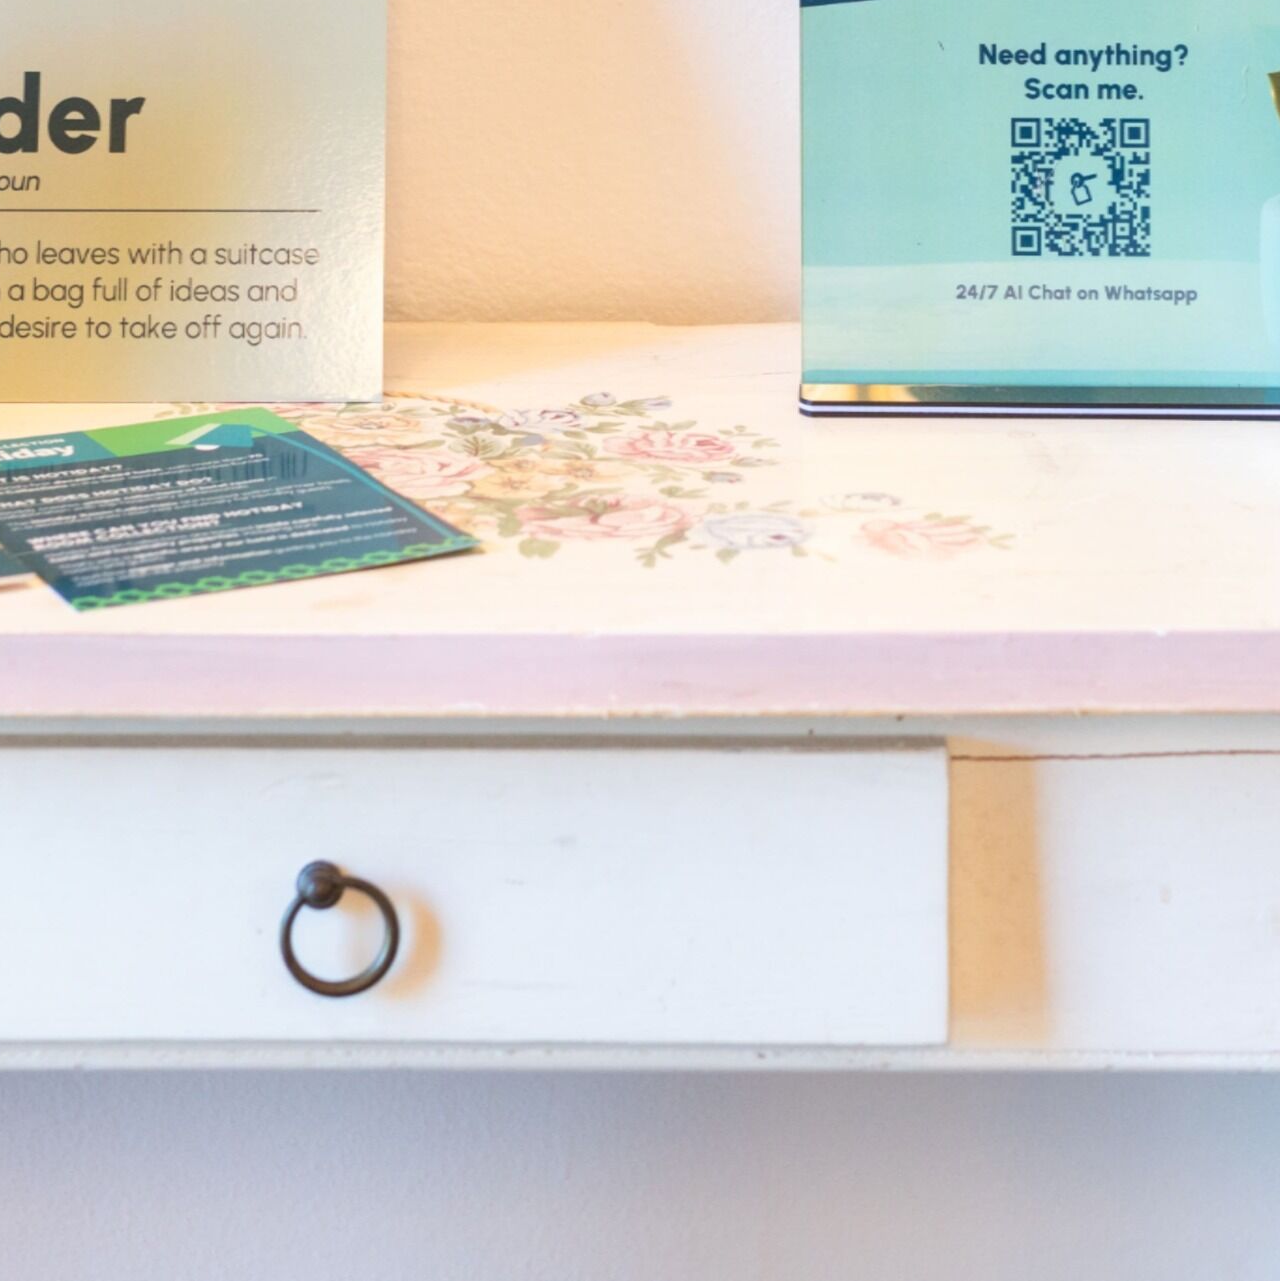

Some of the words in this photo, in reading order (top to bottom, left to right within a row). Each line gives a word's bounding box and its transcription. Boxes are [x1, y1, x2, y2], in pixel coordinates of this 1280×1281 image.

[978, 42, 1047, 65] Need
[1054, 42, 1189, 72] anything?
[1024, 77, 1090, 100] Scan
[1097, 83, 1144, 100] me.
[36, 240, 120, 265] leaves
[128, 240, 183, 265] with
[190, 247, 208, 265] a
[215, 243, 320, 265] suitcase
[7, 283, 25, 302] a
[32, 277, 85, 309] bag
[92, 277, 128, 302] full
[135, 277, 162, 302] of
[169, 277, 240, 302] ideas
[247, 278, 298, 302] and
[955, 284, 998, 301] 24/7
[1003, 285, 1022, 300] AI
[1028, 284, 1072, 300] Chat
[1077, 288, 1099, 300] on
[1104, 285, 1198, 306] Whatsapp
[85, 316, 112, 339] to
[120, 315, 178, 339] take
[185, 315, 222, 339] off
[228, 317, 308, 347] again.
[33, 464, 123, 481] HOTIDAY?
[223, 501, 303, 518] HOTIDAY
